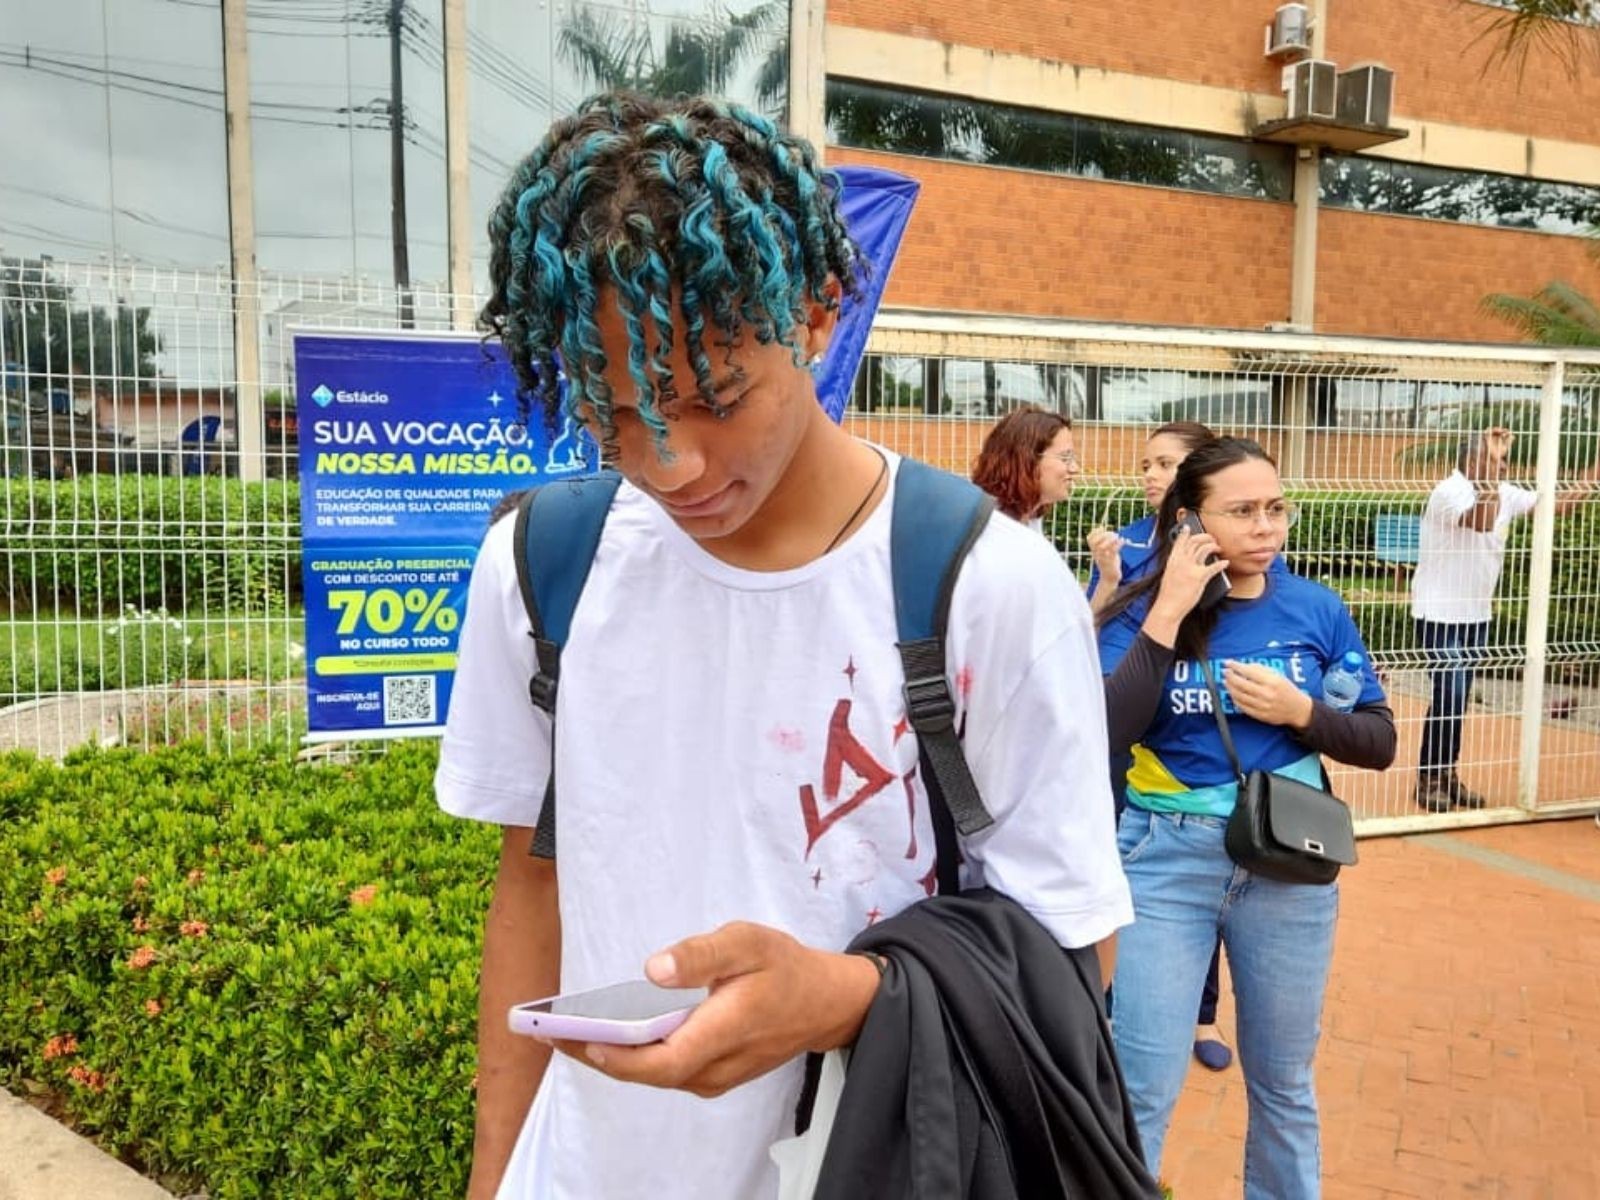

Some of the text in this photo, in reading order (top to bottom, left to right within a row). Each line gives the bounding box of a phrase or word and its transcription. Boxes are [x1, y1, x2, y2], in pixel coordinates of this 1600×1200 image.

[336, 390, 388, 404] Estácio
[314, 418, 533, 450] SUA VOCAÇÃO,
[316, 449, 537, 474] NOSSA MISSÃO.
[316, 487, 503, 501] EDUCAÇÃO DE QUALIDADE PARA
[317, 502, 490, 512] TRANSFORMAR SUA CARREIRA
[317, 515, 397, 526] DE VERDADE.
[311, 558, 471, 572] GRADUAÇÃO PRESENCIAL
[324, 571, 459, 584] COM DESCONTO DE ATÉ
[328, 588, 458, 634] 70%
[340, 636, 449, 650] NO CURSO TODO
[1174, 660, 1188, 683] O
[1290, 651, 1306, 683] É
[356, 702, 380, 711] AQUI
[1170, 688, 1213, 714] SER
